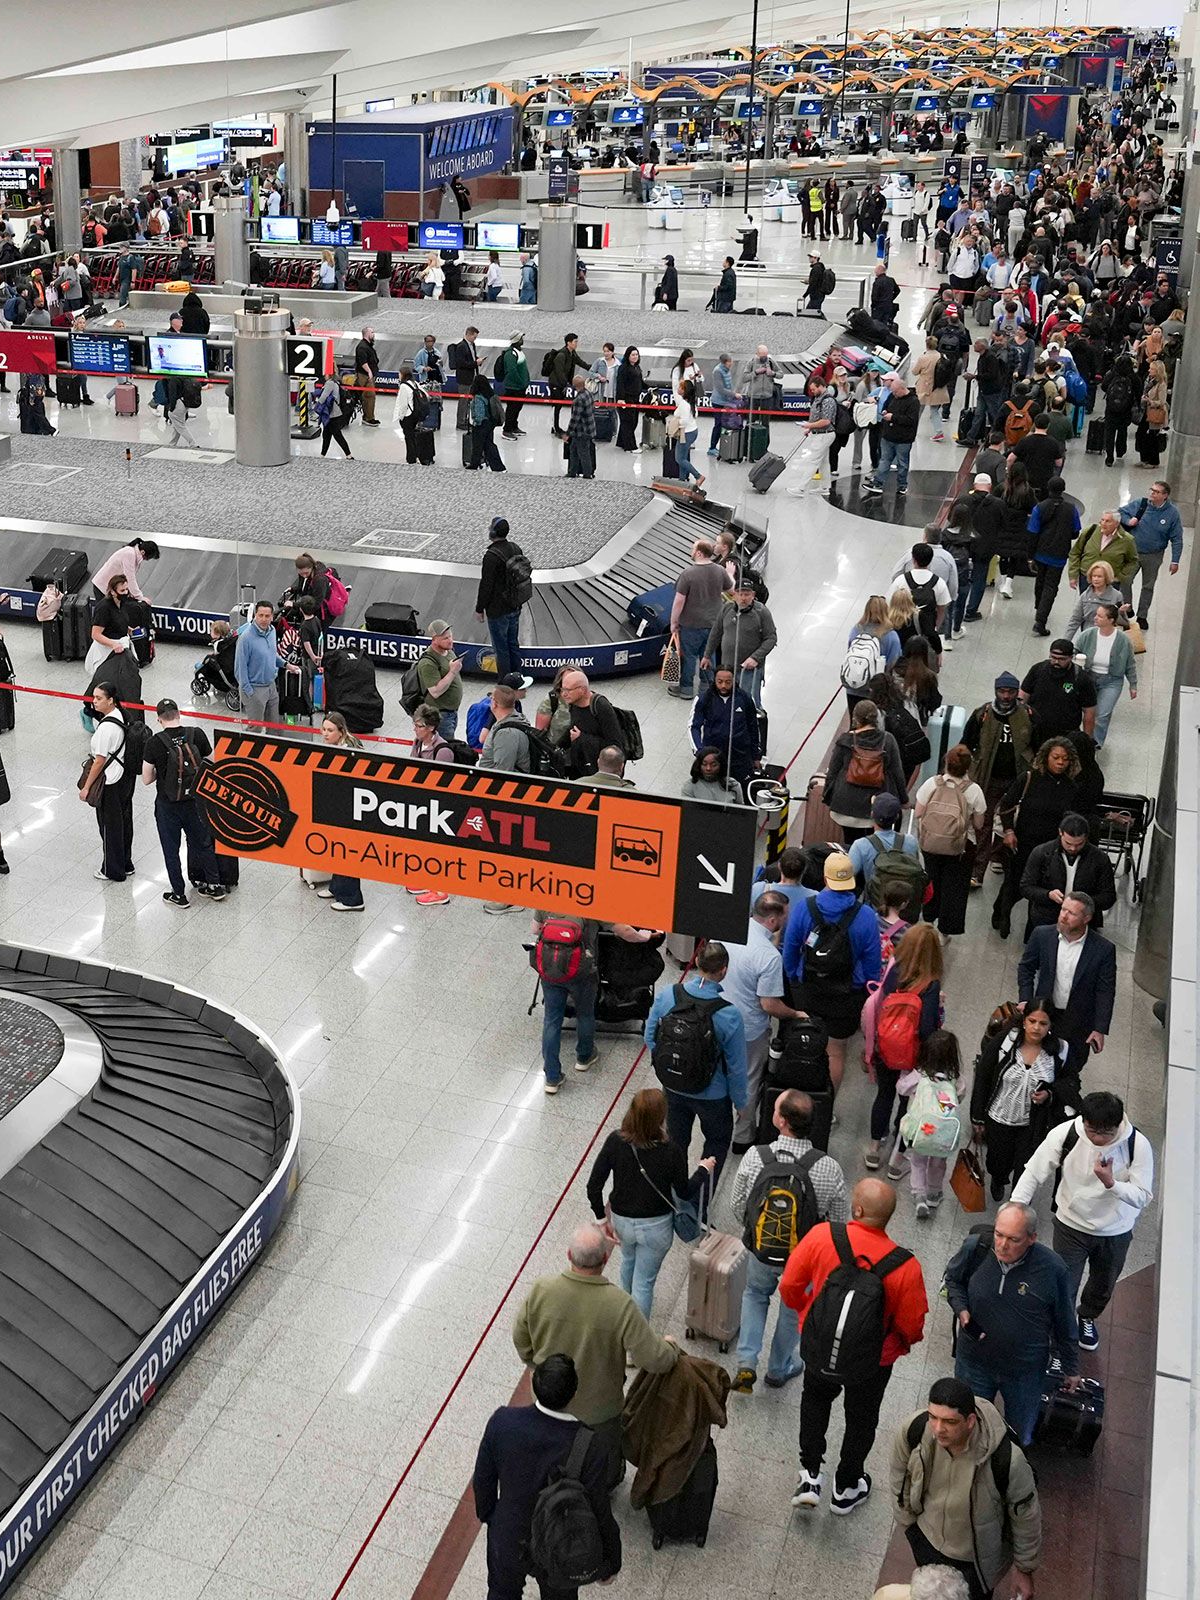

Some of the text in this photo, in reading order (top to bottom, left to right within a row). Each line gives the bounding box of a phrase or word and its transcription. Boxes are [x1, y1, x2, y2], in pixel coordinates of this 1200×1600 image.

[429, 150, 494, 179] WELCOME ABOARD
[199, 215, 207, 234] 1
[585, 226, 593, 247] 1
[364, 237, 371, 249] 1
[294, 344, 315, 374] 2
[525, 384, 545, 398] ATL,
[326, 634, 357, 650] BAG
[360, 638, 398, 658] FLIES
[203, 777, 282, 831] DETOUR
[352, 787, 551, 852] ParkATL
[305, 832, 595, 906] On-Airport Parking
[35, 1445, 85, 1531] FIRST
[86, 1354, 159, 1463] CHECKED
[161, 1315, 193, 1369] BAG
[193, 1268, 230, 1326] FLIES
[230, 1219, 263, 1277] FREE
